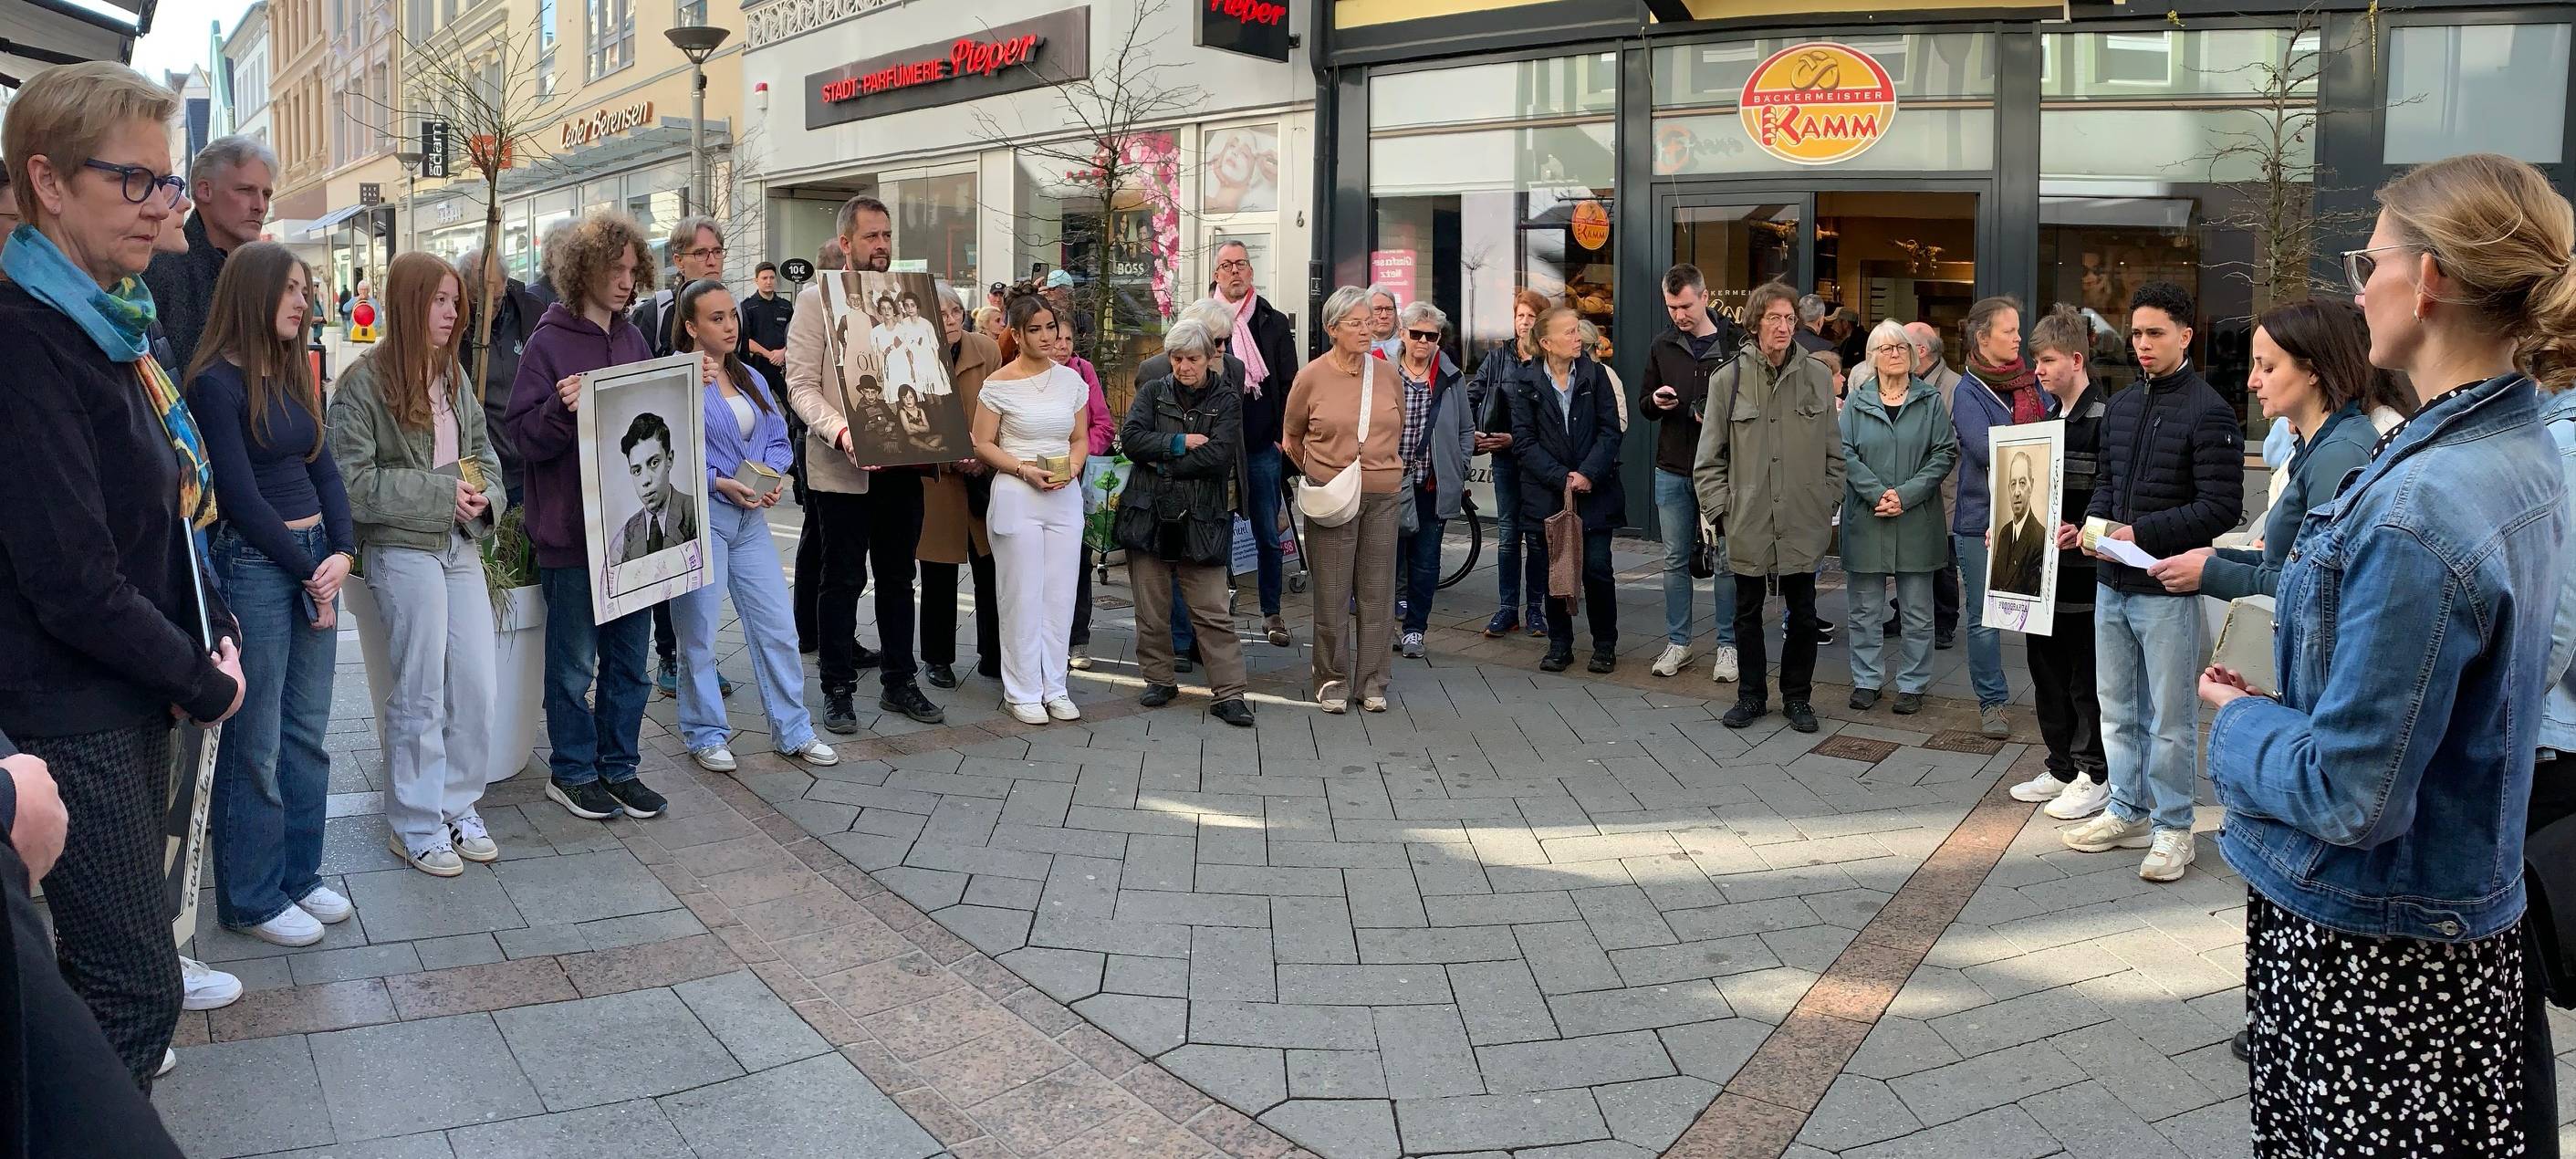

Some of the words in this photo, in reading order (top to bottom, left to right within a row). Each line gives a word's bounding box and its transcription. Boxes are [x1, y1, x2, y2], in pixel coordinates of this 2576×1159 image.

[950, 34, 1038, 78] Pieper
[1754, 91, 1883, 104] BÄCKERMEISTER
[560, 120, 590, 149] Leder
[591, 101, 650, 139] Berensen
[1297, 210, 1305, 227] 6
[1114, 263, 1145, 275] BOSS
